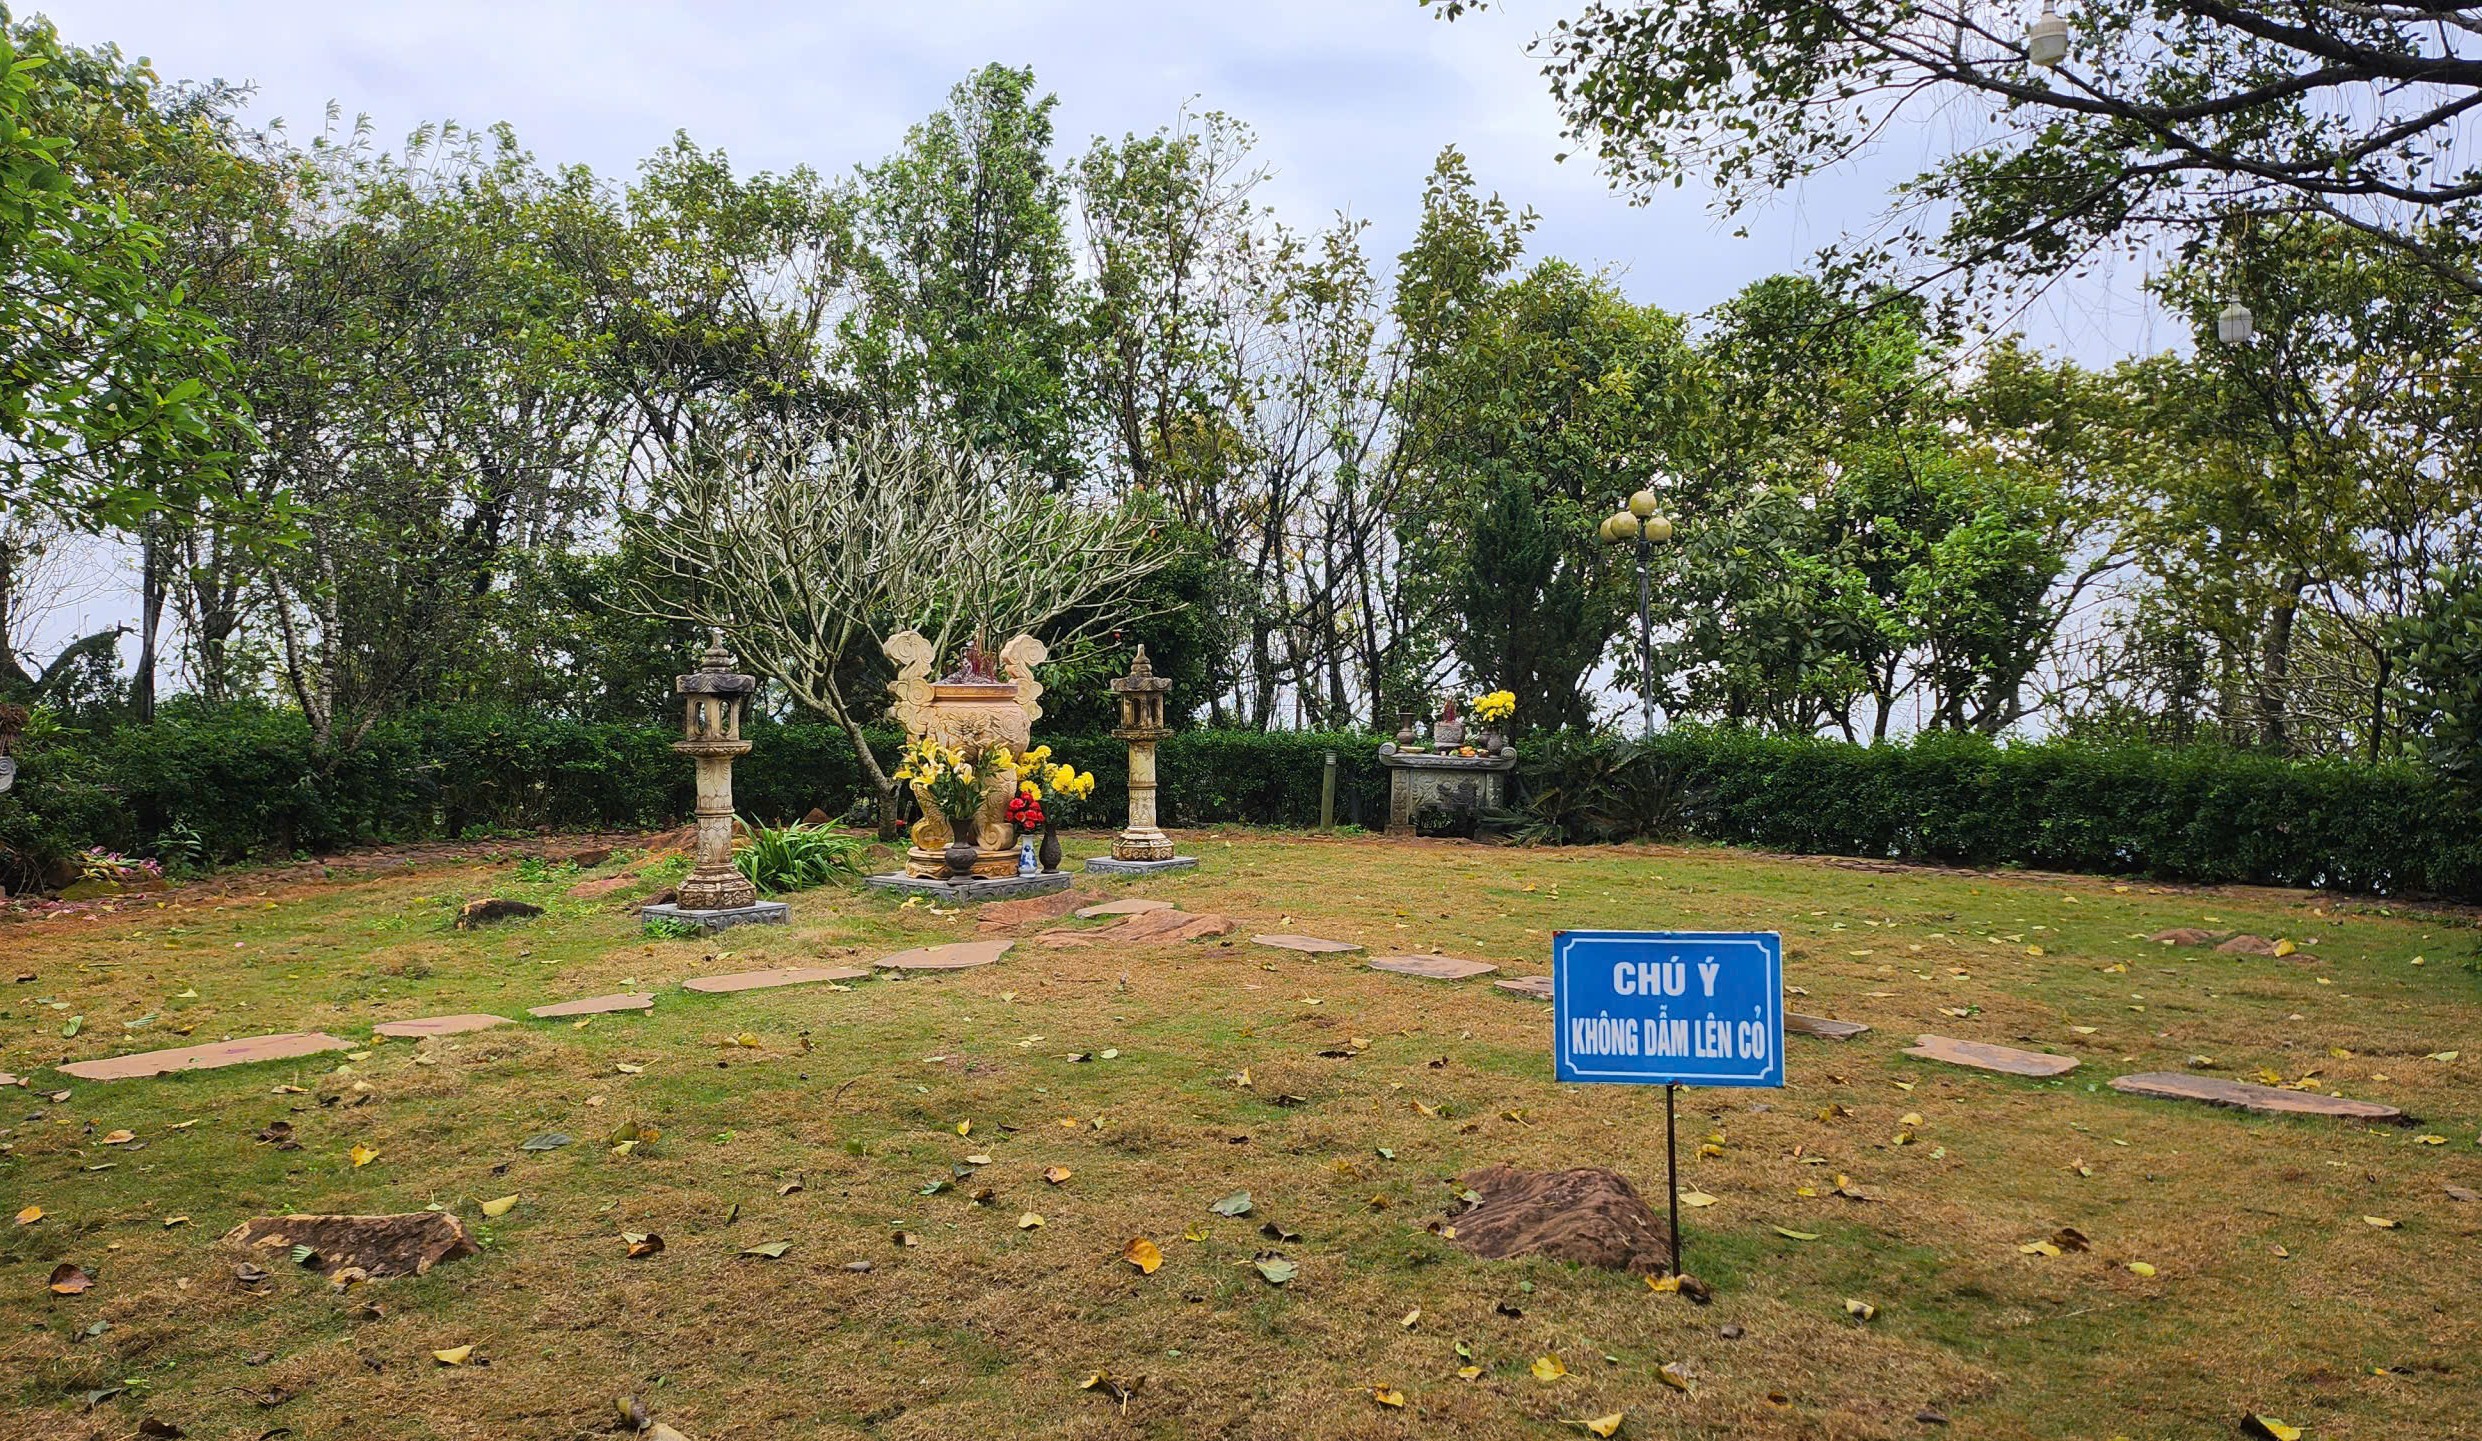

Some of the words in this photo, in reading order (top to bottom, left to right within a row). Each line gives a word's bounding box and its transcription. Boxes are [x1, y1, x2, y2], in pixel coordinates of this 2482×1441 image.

[1613, 956, 1686, 996] CHÚ
[1698, 956, 1720, 997] Ý
[1572, 1010, 1638, 1056] KHÔNG
[1644, 1005, 1688, 1057] DẪM
[1695, 1012, 1732, 1058] LÊN
[1738, 1005, 1766, 1060] CỎ
